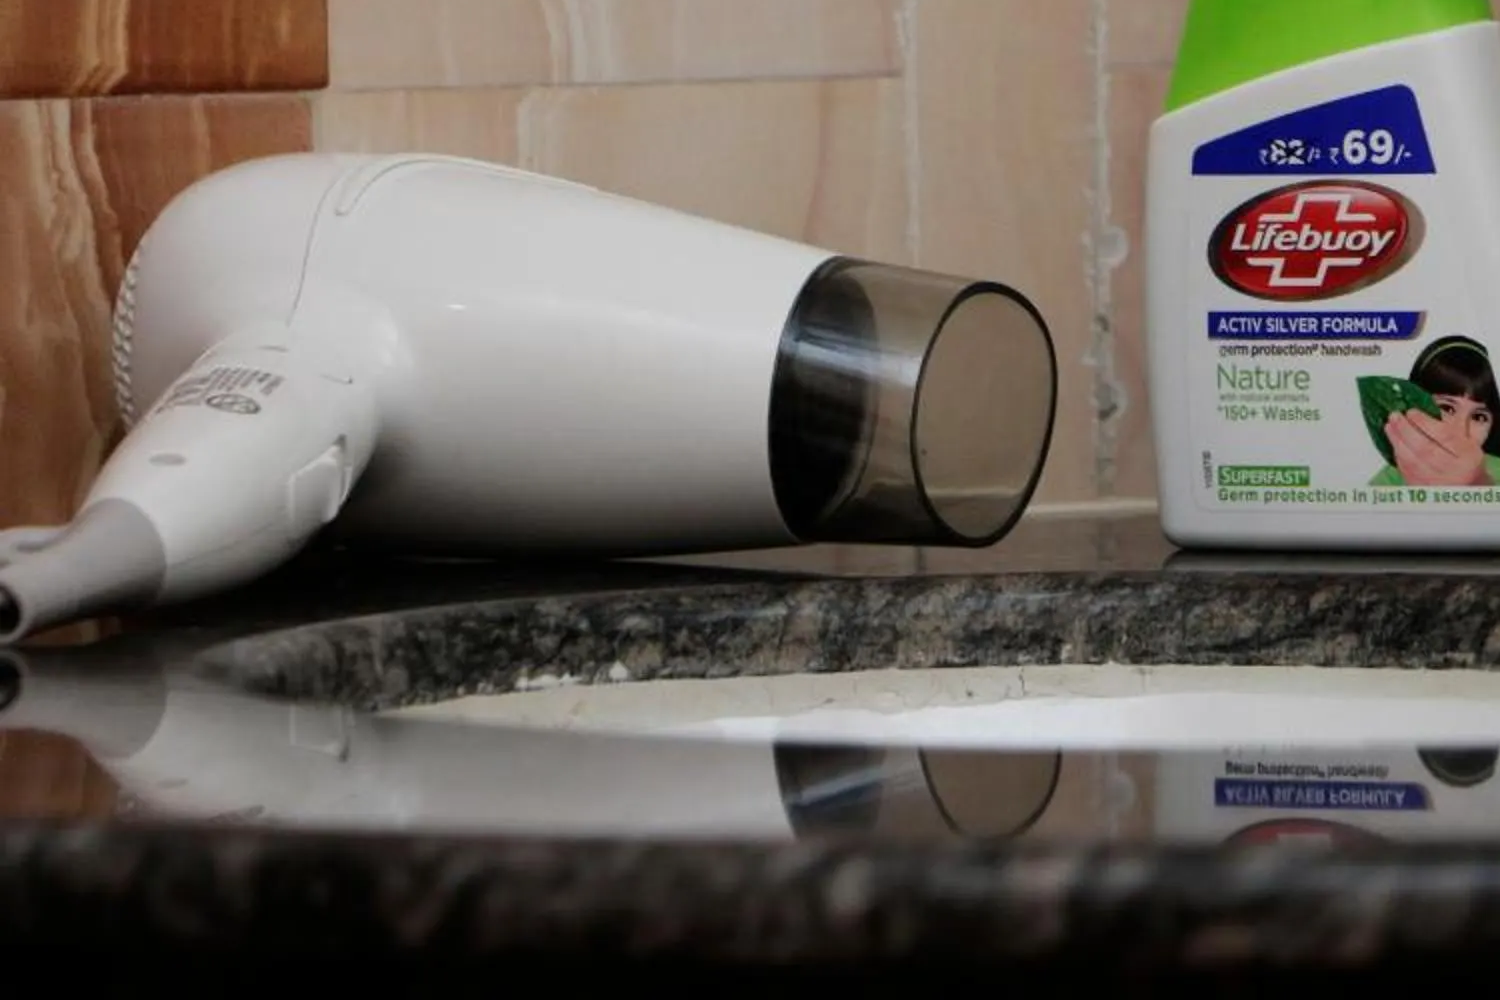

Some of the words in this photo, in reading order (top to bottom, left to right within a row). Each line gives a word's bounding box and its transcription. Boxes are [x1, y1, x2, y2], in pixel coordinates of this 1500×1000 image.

[1231, 223, 1396, 257] Lifebuoy
[1217, 317, 1262, 333] ACTIV
[1266, 317, 1317, 333] SILVER
[1321, 317, 1399, 333] FORMULA
[1217, 363, 1311, 390] Nature
[1262, 404, 1321, 421] Washes
[1218, 488, 1258, 502] Germ
[1264, 488, 1348, 505] protection
[1353, 488, 1368, 502] in
[1372, 488, 1403, 505] just
[1408, 489, 1428, 503] 10
